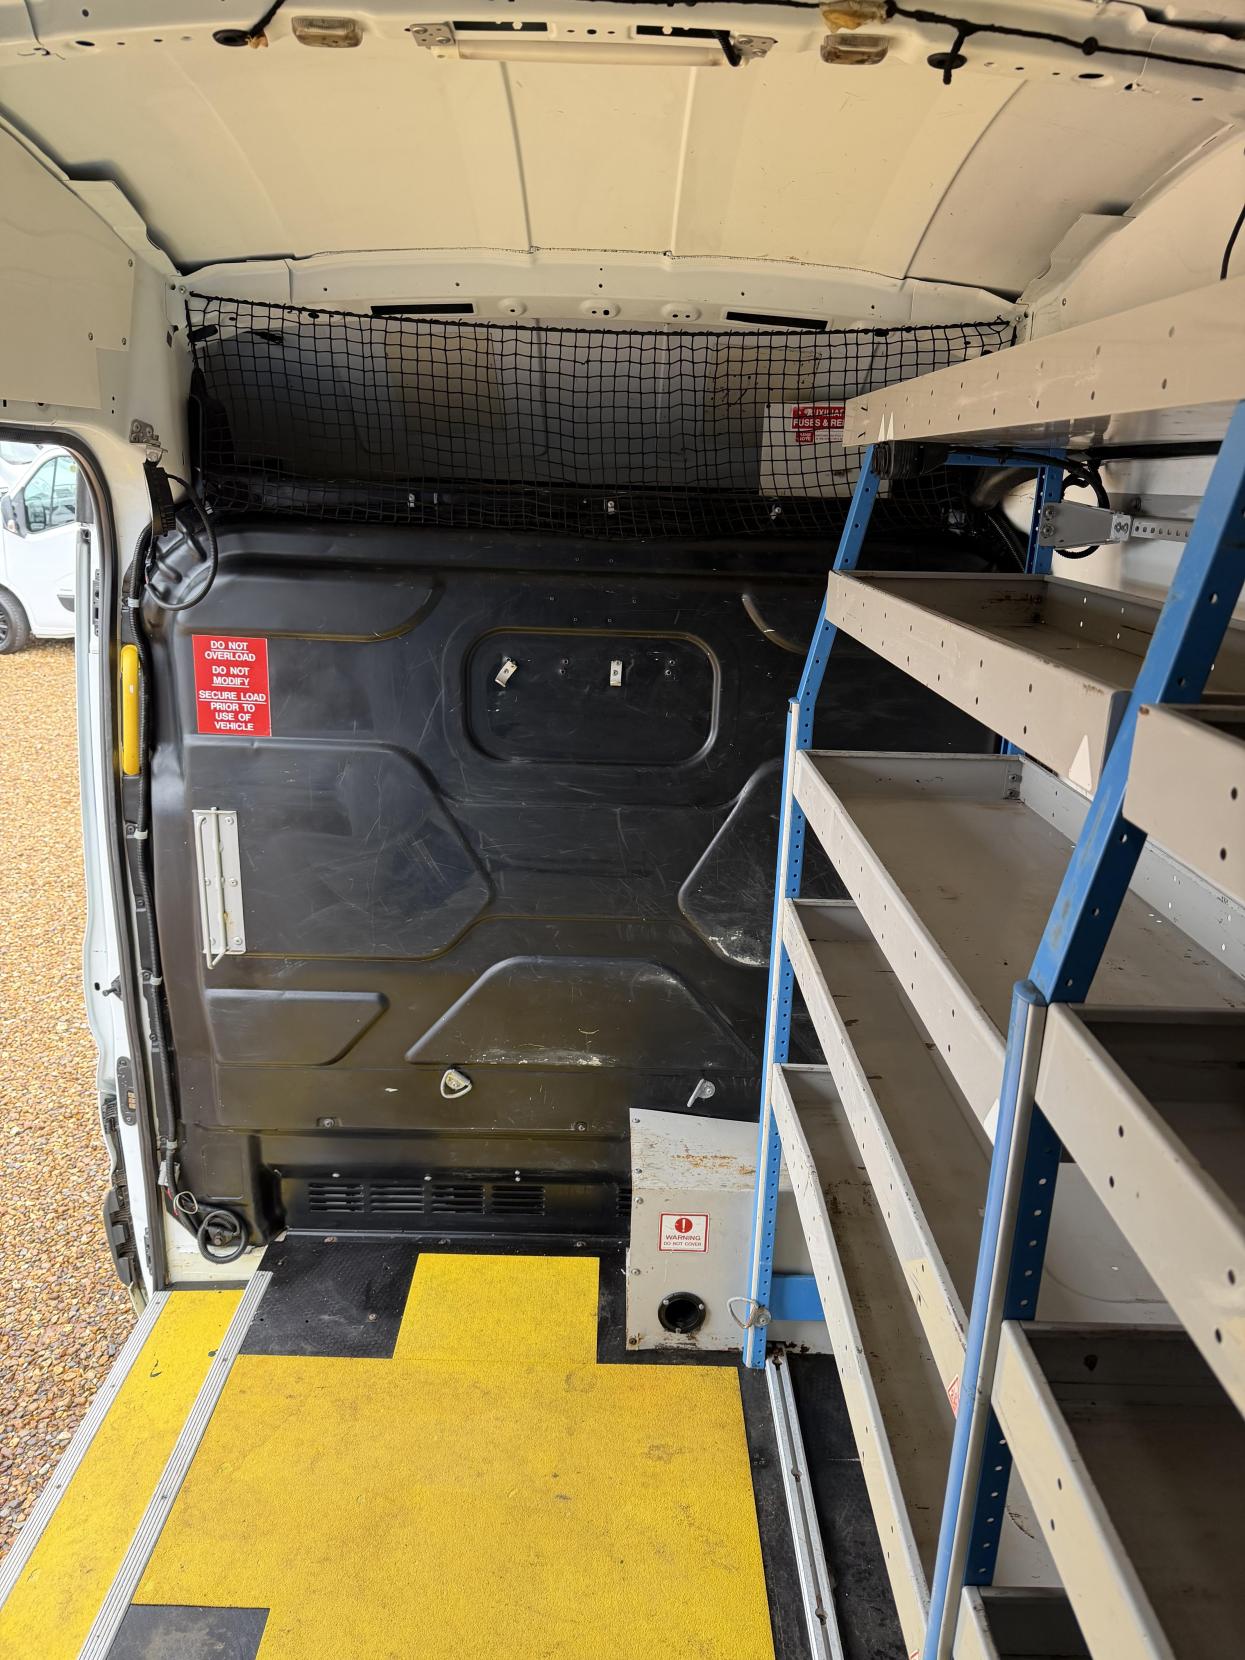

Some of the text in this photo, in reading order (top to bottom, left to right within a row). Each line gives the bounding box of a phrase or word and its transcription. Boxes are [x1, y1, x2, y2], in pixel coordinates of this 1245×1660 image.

[793, 418, 821, 427] FUSES
[822, 418, 829, 427] &
[210, 640, 248, 650] DO NOT
[204, 651, 256, 662] OVERLOAD
[212, 666, 250, 675] DO NOT
[213, 676, 250, 686] MODIFY
[198, 690, 266, 701] SECURE LOAD
[210, 702, 255, 712] PRIOR TO
[215, 712, 252, 721] USE OF
[214, 722, 254, 731] VEHICLE
